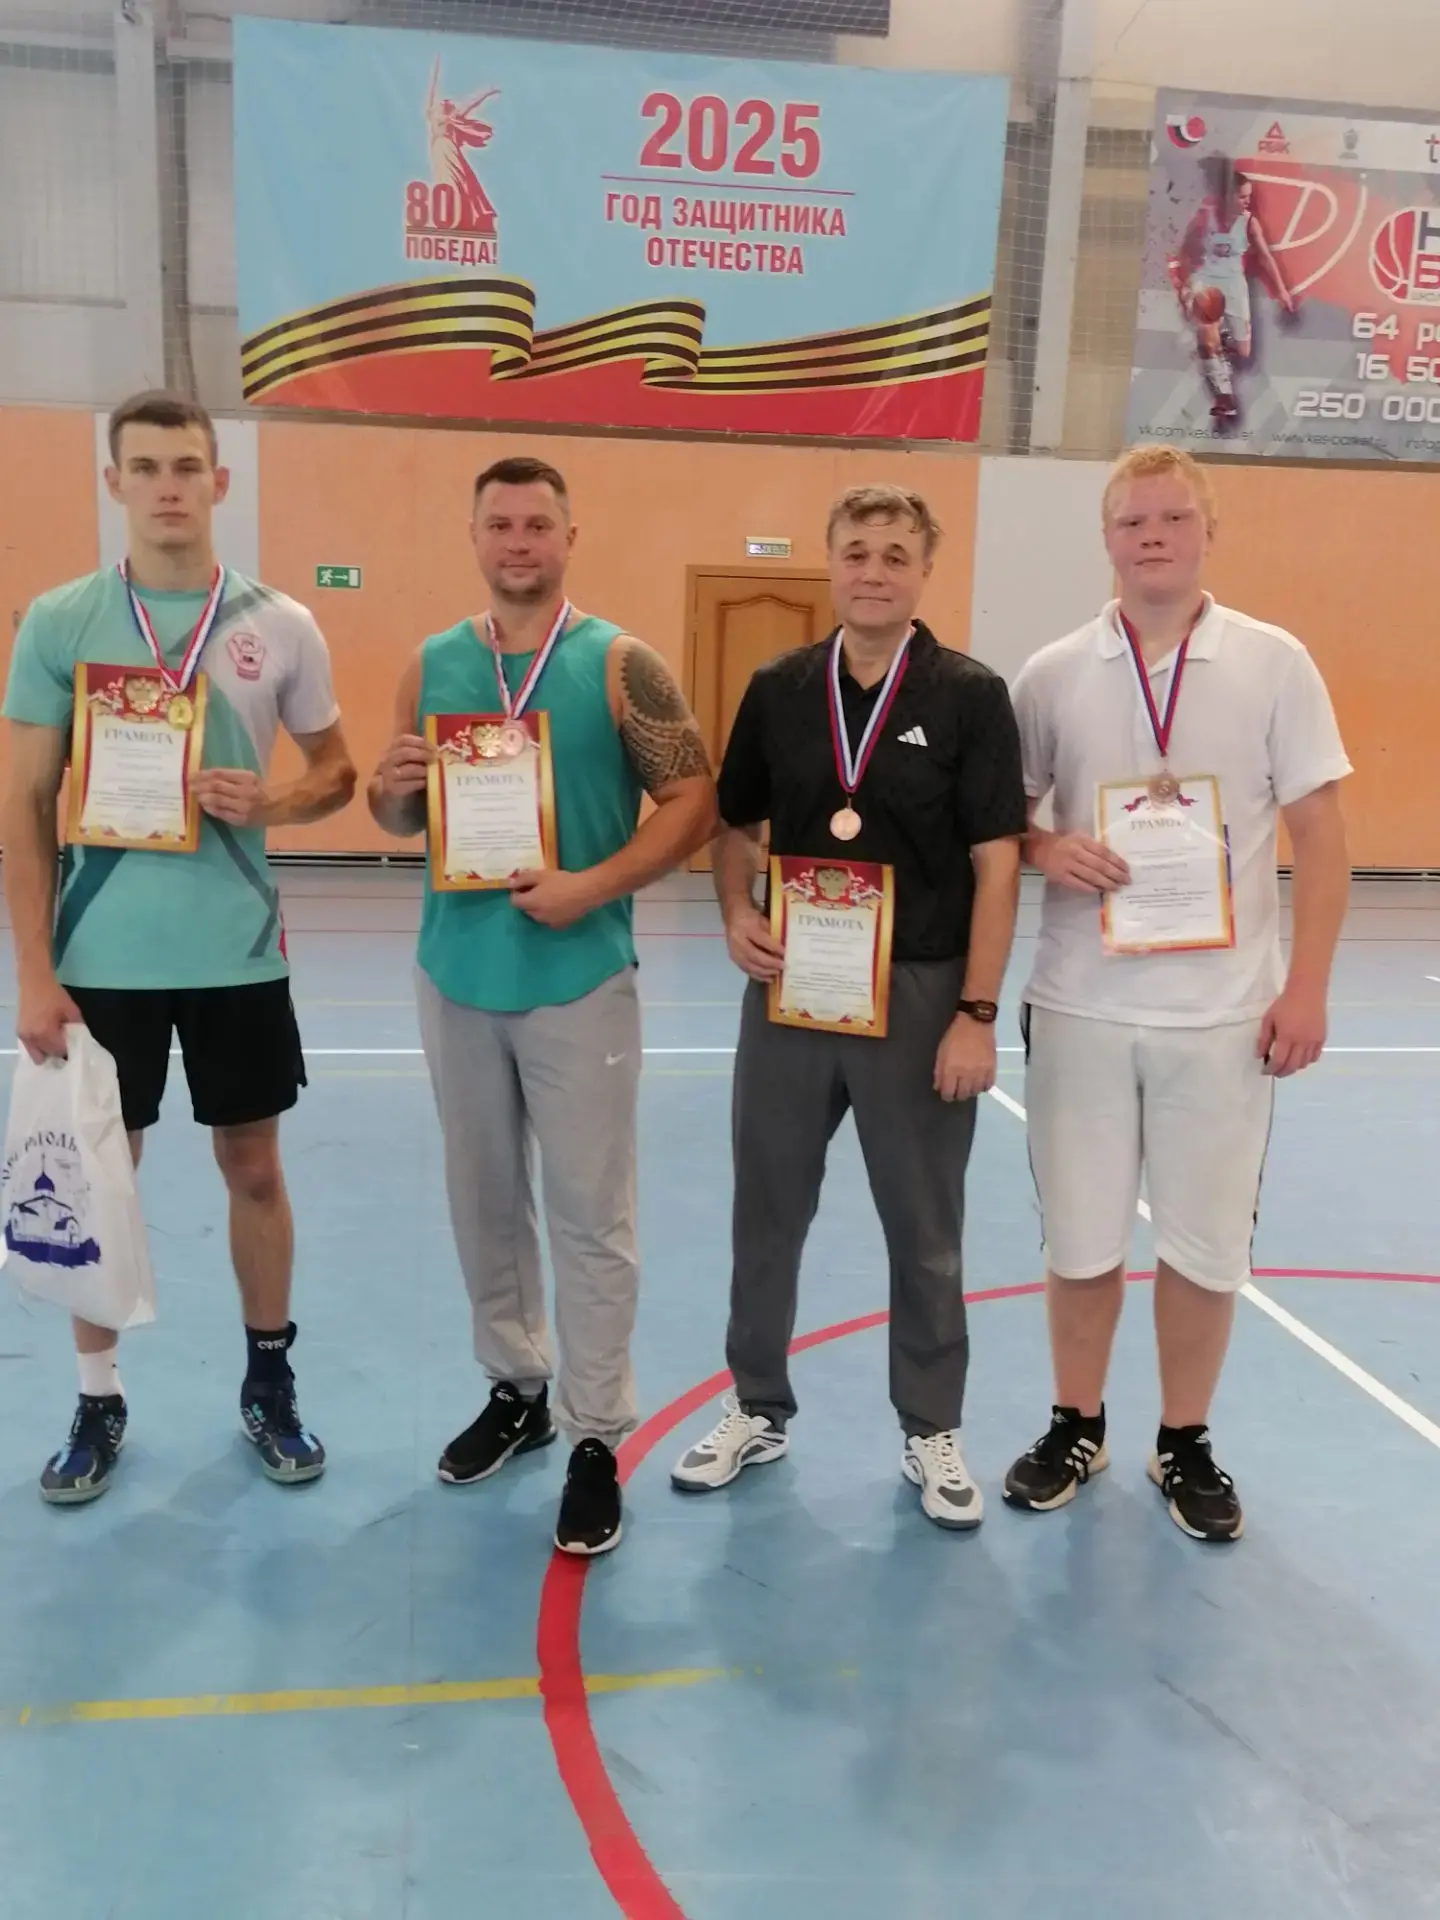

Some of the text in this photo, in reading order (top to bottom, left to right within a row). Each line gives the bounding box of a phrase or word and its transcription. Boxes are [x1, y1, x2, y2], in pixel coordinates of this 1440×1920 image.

[639, 92, 821, 179] 2025
[406, 181, 456, 229] 80
[606, 193, 847, 236] ГОД ЗАЩИТНИКА
[405, 236, 497, 266] ПОБЕДА!
[646, 236, 804, 275] ОТЕЧЕСТВА
[1352, 312, 1400, 340] 64
[1356, 353, 1390, 380] 16
[1293, 391, 1366, 419] 250
[103, 727, 174, 745] ГРАМОТА
[797, 914, 865, 931] ГРАМОТА
